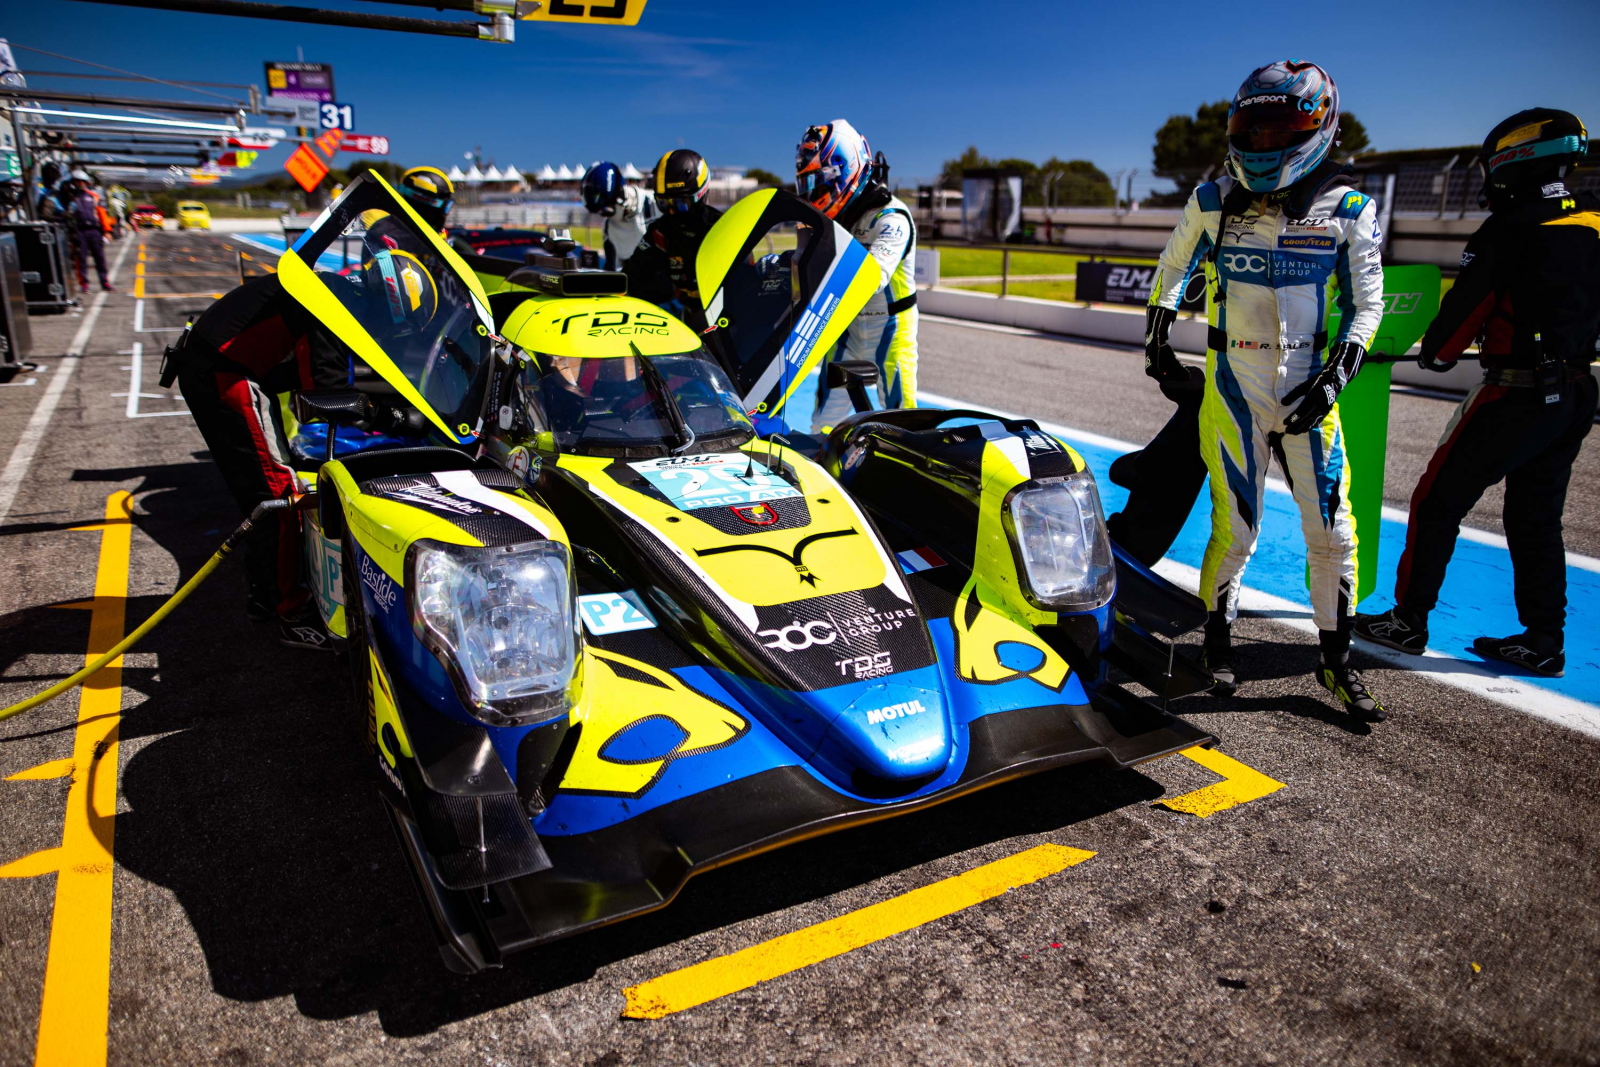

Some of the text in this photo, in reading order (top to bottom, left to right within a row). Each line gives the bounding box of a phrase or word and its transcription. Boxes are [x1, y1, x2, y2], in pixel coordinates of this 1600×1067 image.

[321, 104, 352, 130] 31
[1490, 146, 1535, 168] 100%
[1346, 194, 1363, 208] P1
[1230, 213, 1260, 225] DS
[1274, 260, 1322, 269] VENTURE
[552, 311, 668, 335] TDS
[588, 327, 670, 337] RACING
[796, 344, 816, 368] PODIUM
[661, 464, 771, 497] 29
[684, 489, 800, 509] PRO AM
[361, 555, 397, 607] Bastide
[581, 598, 648, 628] P2
[841, 608, 916, 628] VENTURE
[849, 620, 904, 638] GROUP
[835, 651, 891, 676] TDS
[854, 664, 894, 679] RACING
[866, 699, 927, 726] MOTUL
